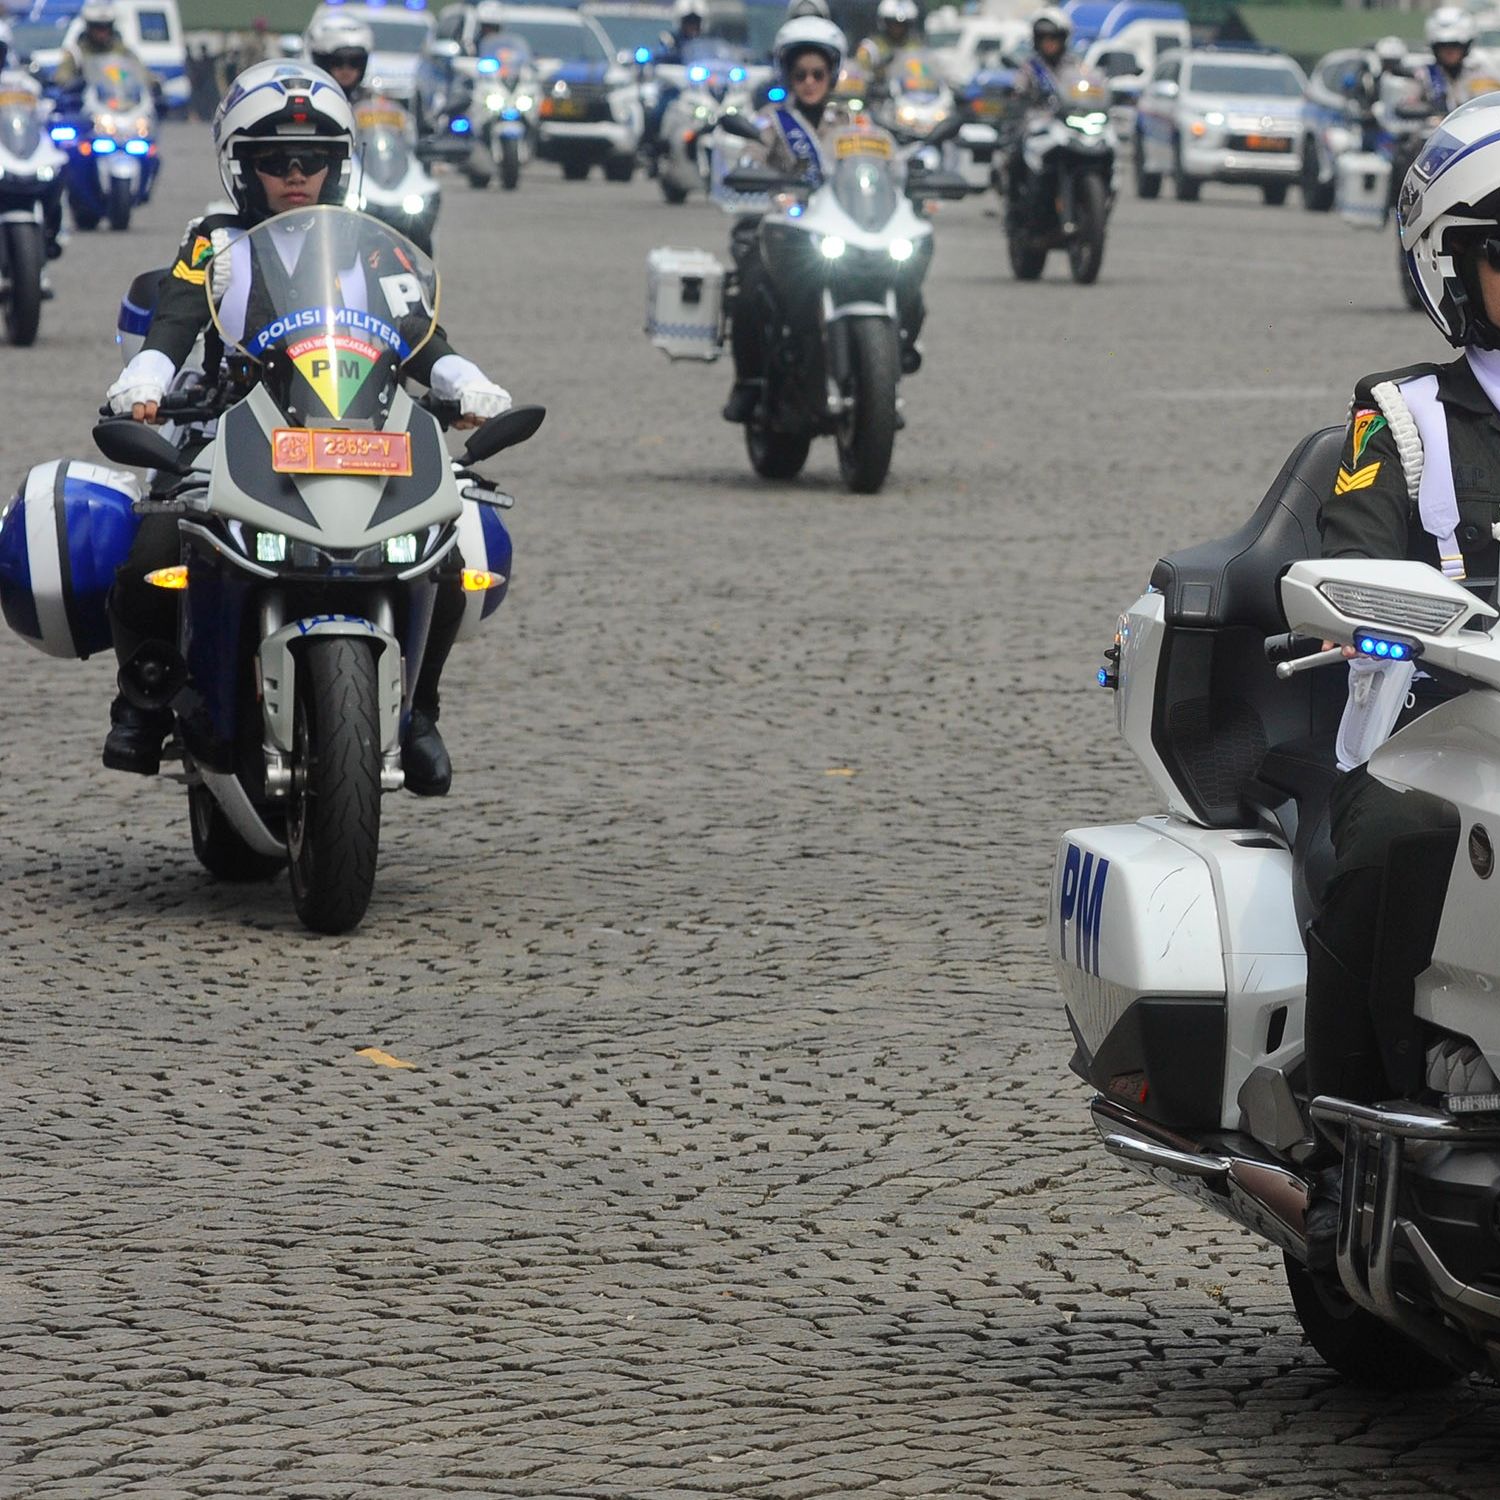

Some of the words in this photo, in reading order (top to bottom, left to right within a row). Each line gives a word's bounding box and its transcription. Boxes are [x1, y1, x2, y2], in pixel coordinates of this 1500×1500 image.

[258, 310, 320, 348] POLISI
[330, 309, 401, 350] MILITER
[311, 359, 360, 380] PM
[1356, 420, 1381, 434] PM
[1060, 843, 1110, 978] PM
